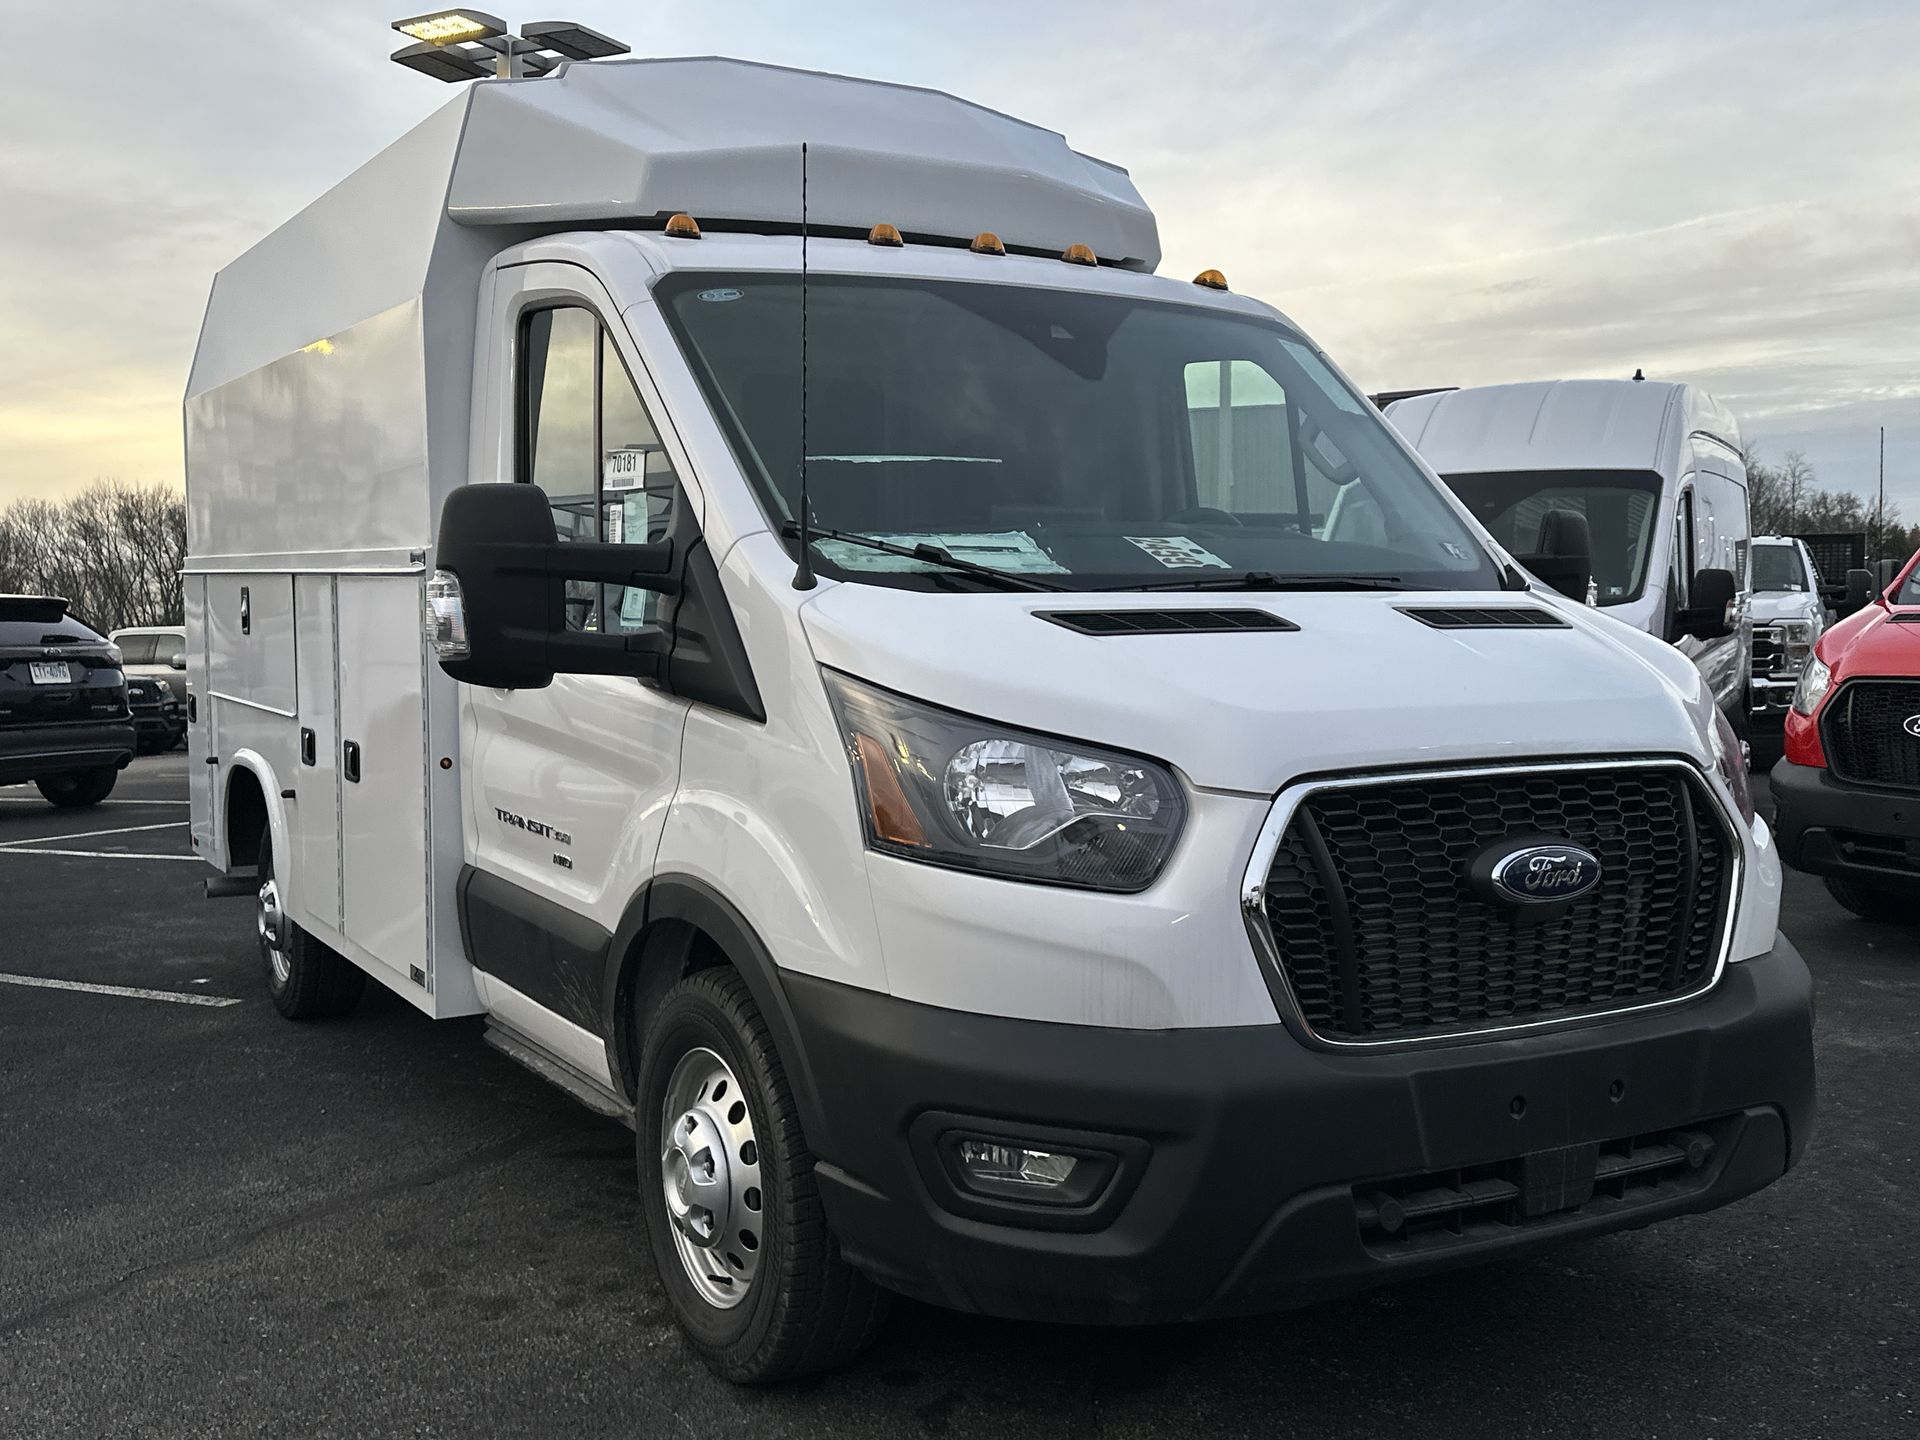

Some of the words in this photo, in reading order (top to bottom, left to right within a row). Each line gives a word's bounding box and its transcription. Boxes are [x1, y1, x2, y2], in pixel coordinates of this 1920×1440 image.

[612, 453, 637, 473] 70181
[494, 807, 554, 839] TRANSIT
[1525, 855, 1583, 891] Ford
